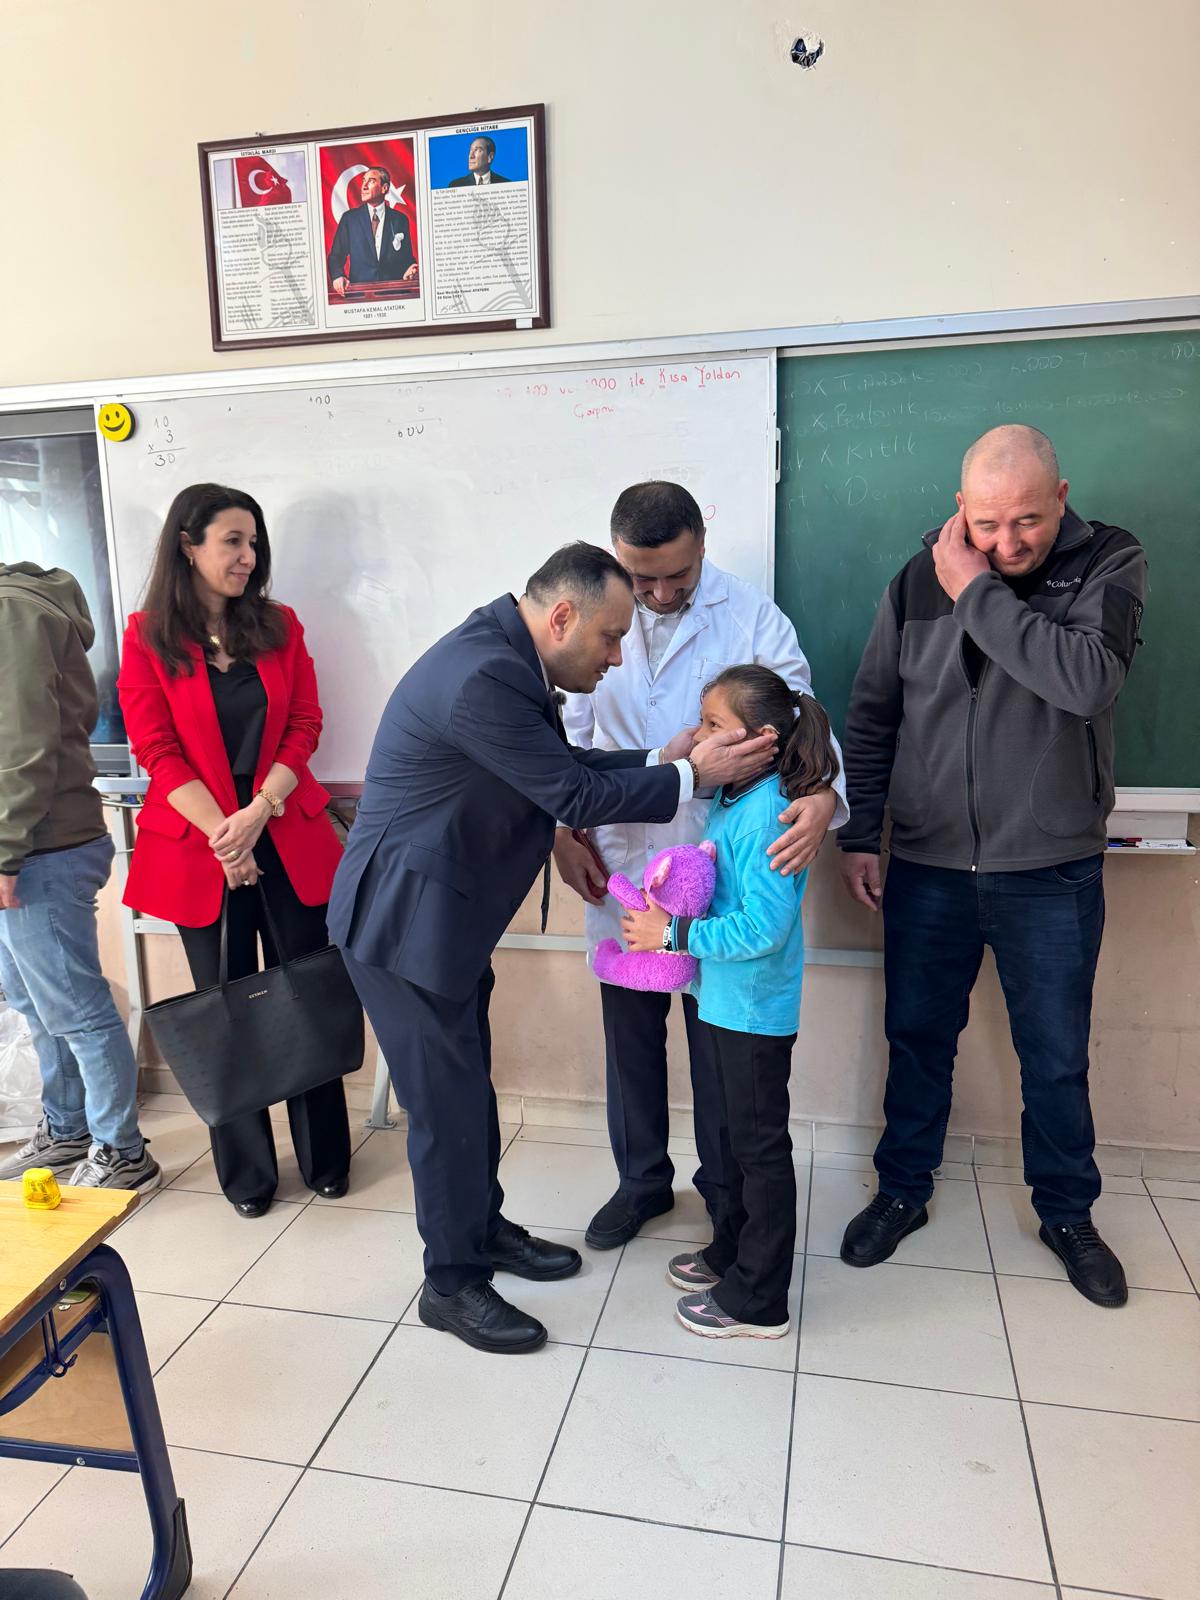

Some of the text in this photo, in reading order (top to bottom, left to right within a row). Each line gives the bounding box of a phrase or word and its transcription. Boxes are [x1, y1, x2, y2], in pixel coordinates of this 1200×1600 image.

[585, 377, 617, 390] 000
[629, 370, 645, 388] ile
[153, 415, 169, 429] 10
[165, 429, 174, 444] 3
[154, 453, 176, 467] 30
